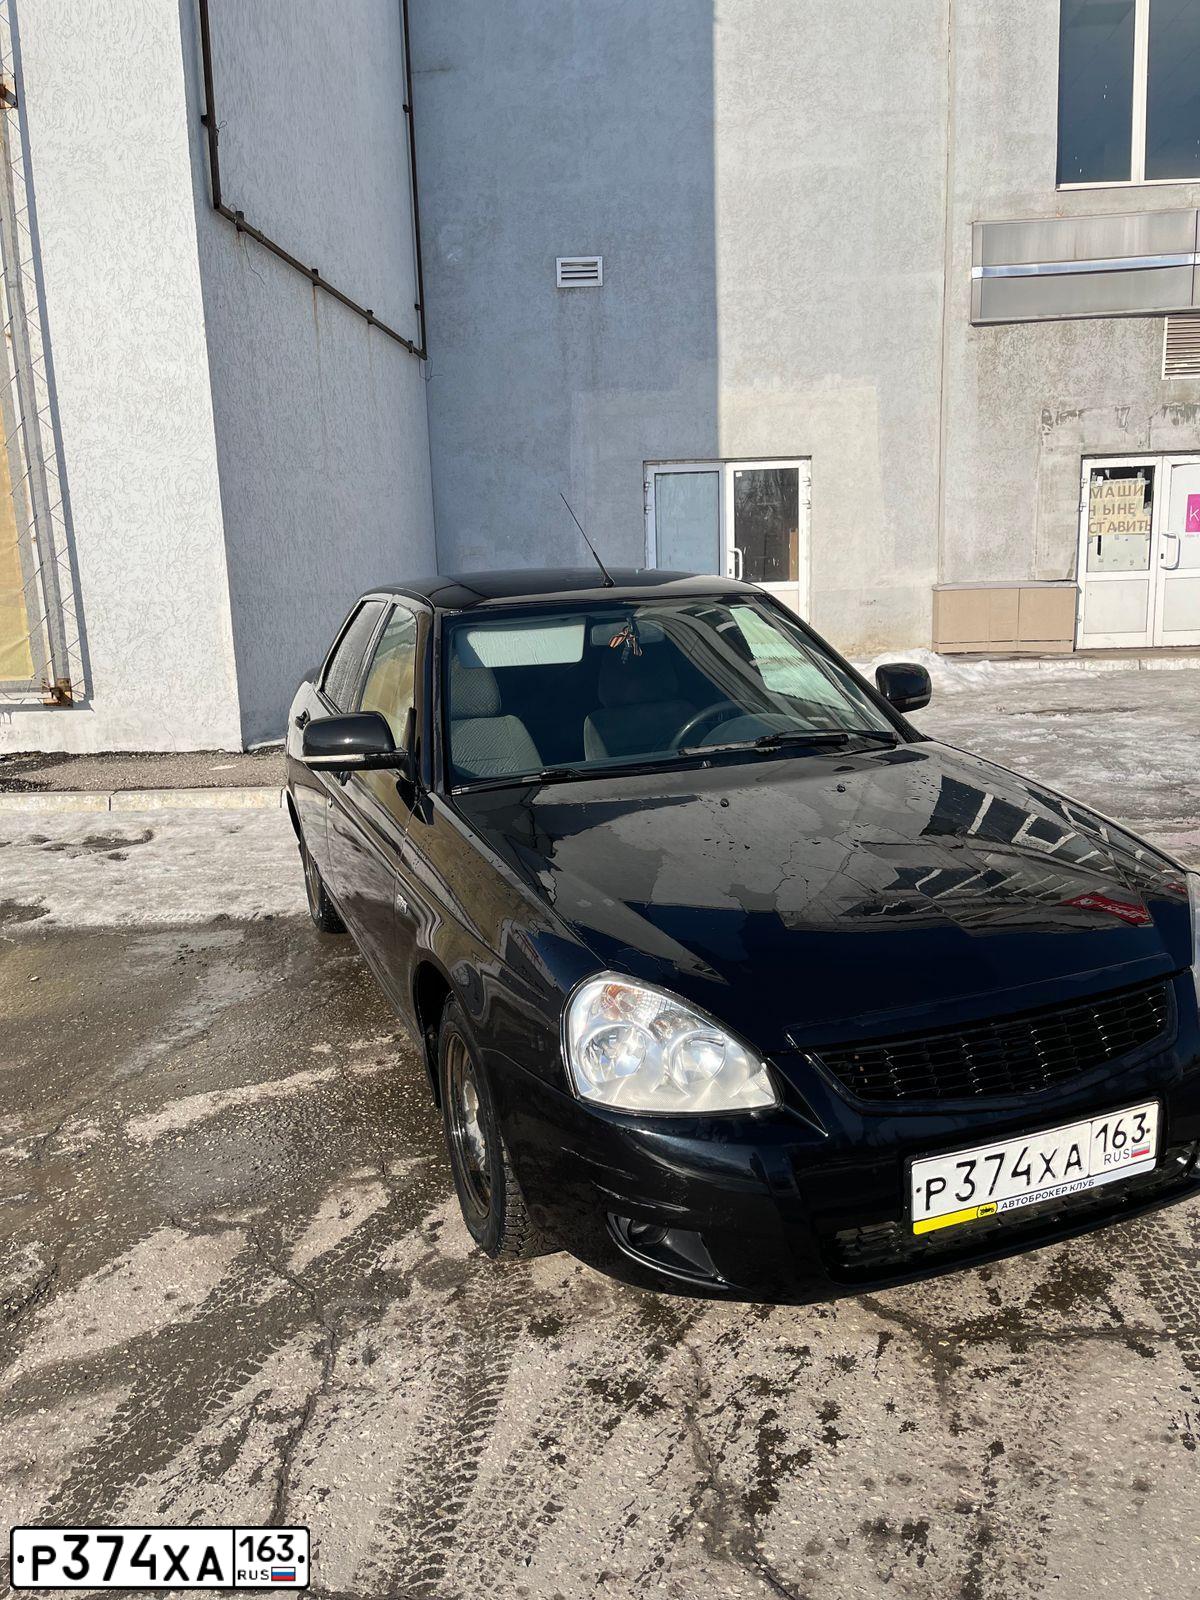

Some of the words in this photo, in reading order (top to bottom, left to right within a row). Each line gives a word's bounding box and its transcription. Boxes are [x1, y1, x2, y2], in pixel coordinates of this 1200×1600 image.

[925, 1143, 1083, 1211] Р374ХА
[1095, 1112, 1147, 1153] 163
[1104, 1149, 1130, 1166] RUS
[1001, 1186, 1068, 1210] АВТОБРОКЕР
[1069, 1179, 1095, 1192] КЛУБ
